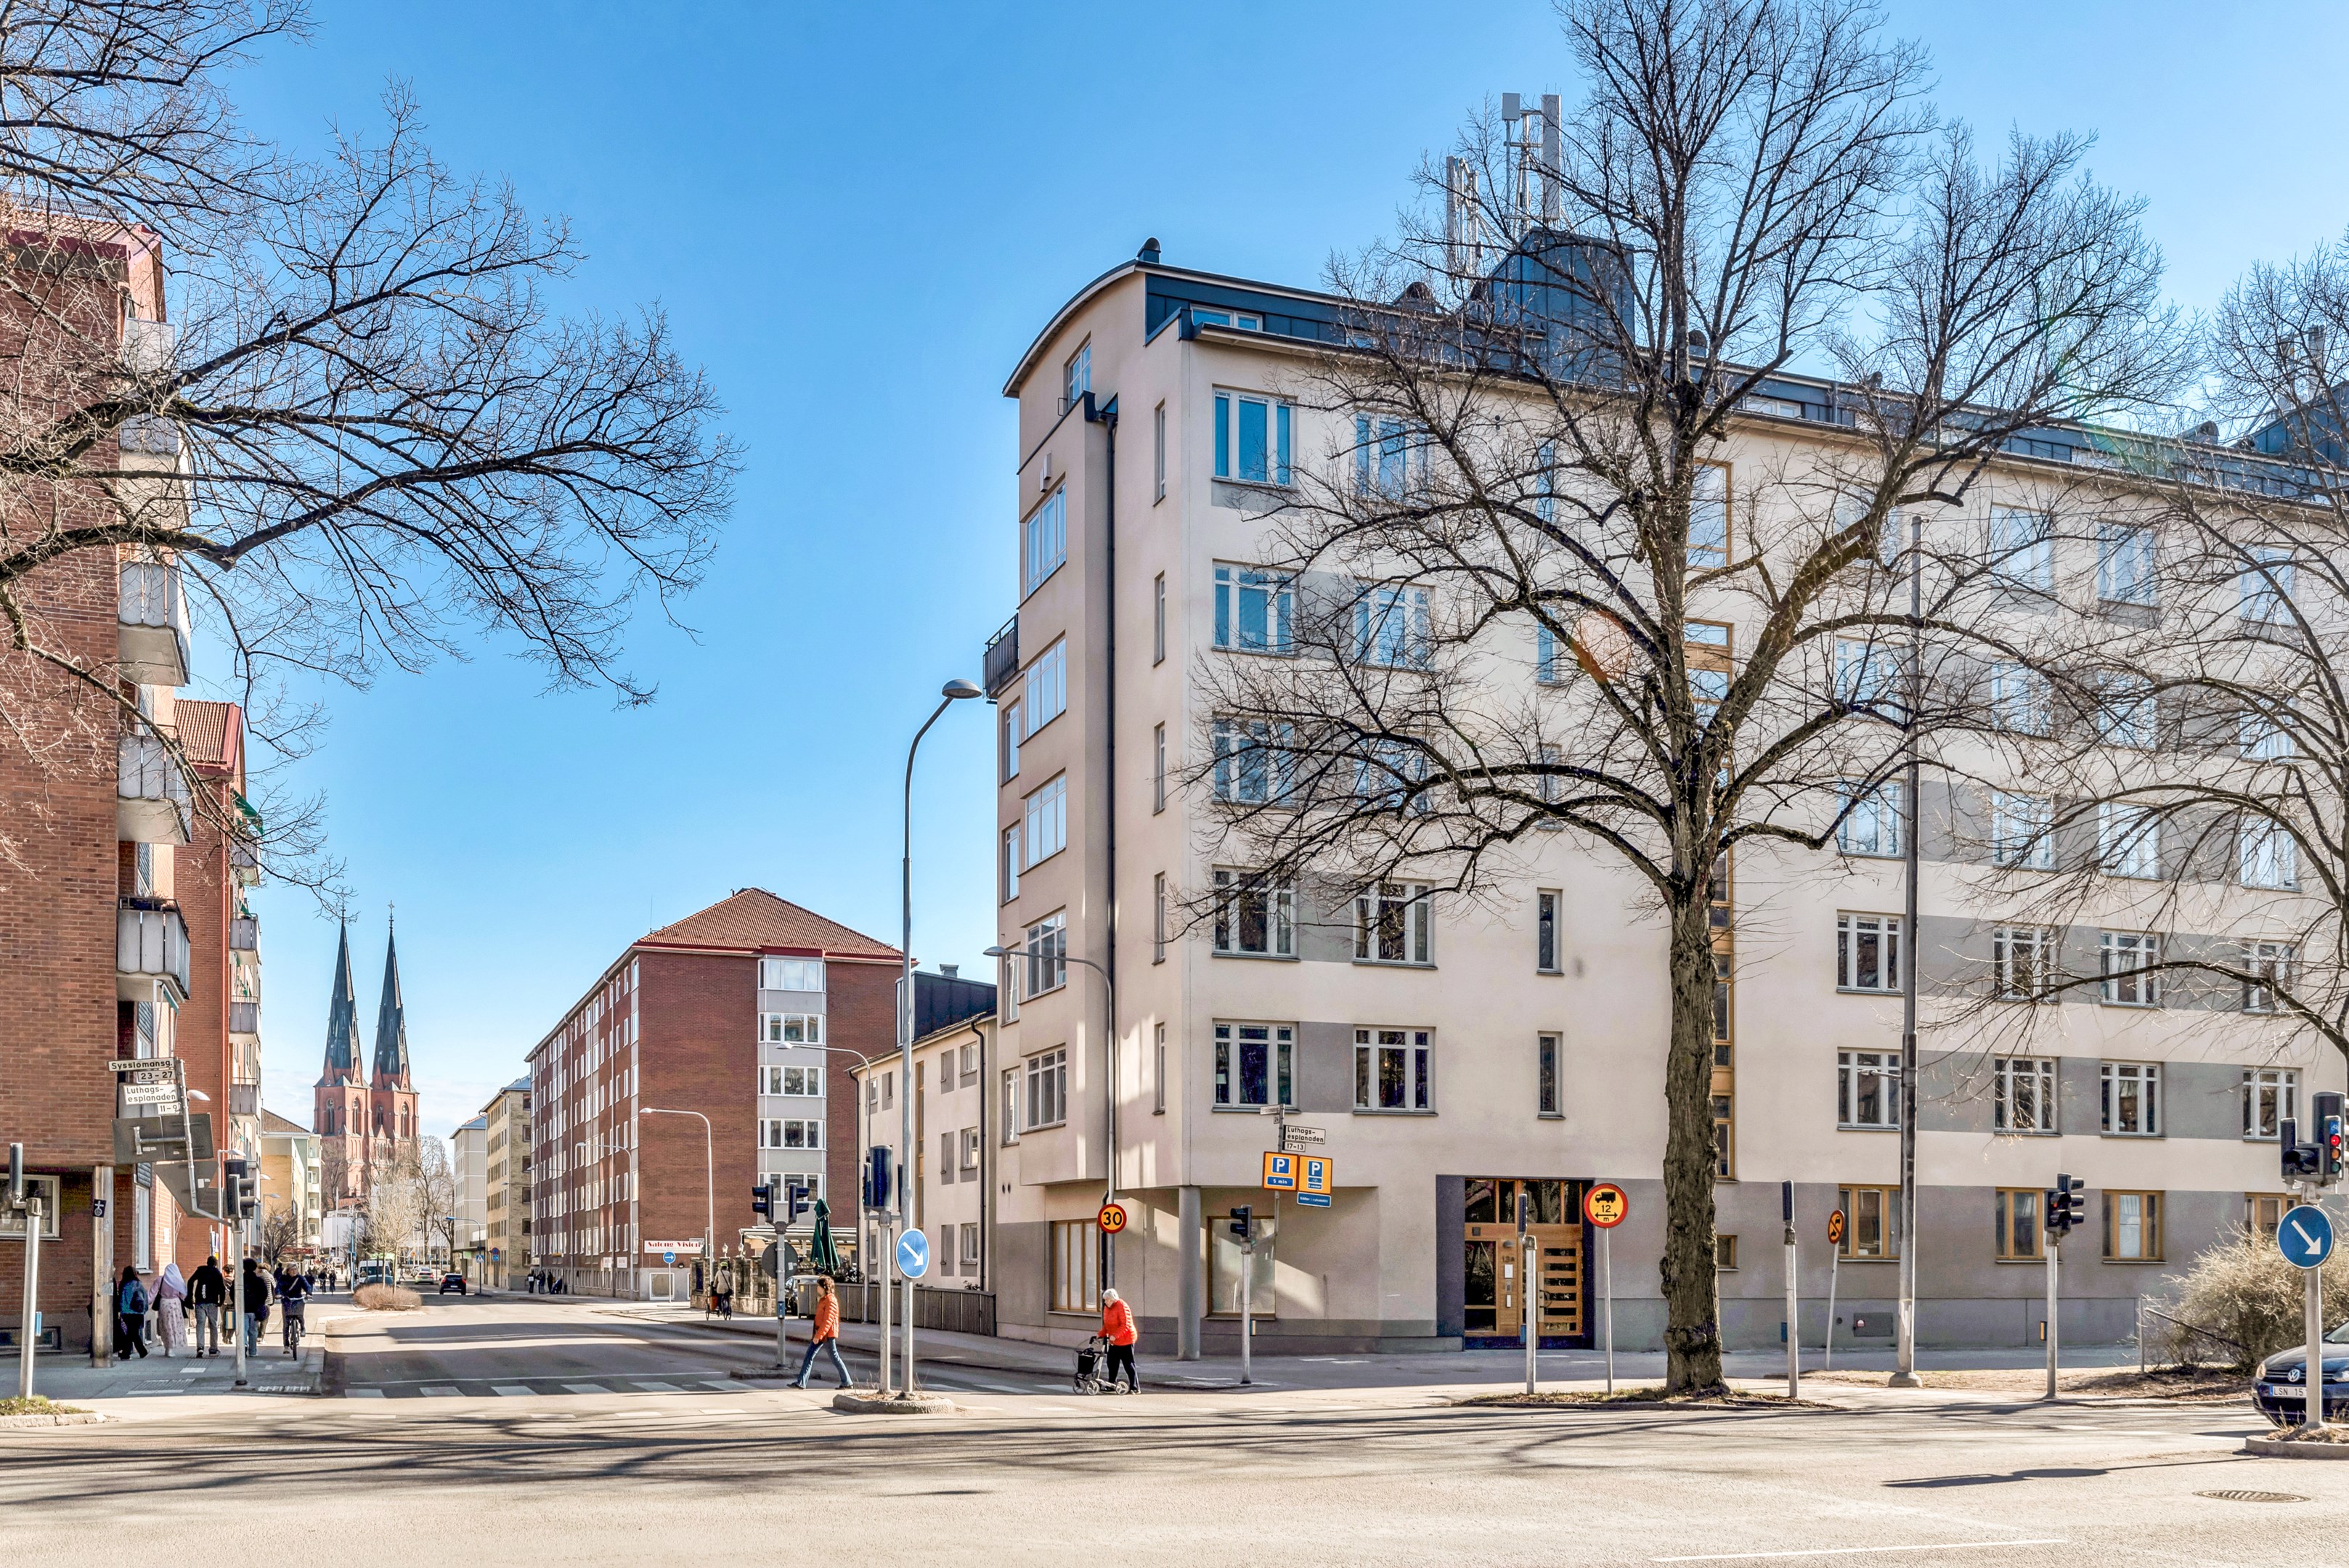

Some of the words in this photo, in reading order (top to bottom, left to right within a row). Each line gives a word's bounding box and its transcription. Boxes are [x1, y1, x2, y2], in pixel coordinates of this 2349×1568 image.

[111, 1060, 173, 1070] Sysslomansg.
[126, 1086, 164, 1095] Luthags-
[128, 1093, 176, 1103] esplanaden
[1287, 1126, 1316, 1135] Luthags-
[1287, 1134, 1324, 1143] esplanaden
[1276, 1159, 1285, 1172] P
[1311, 1162, 1321, 1175] P
[1601, 1204, 1611, 1213] 12
[1103, 1211, 1123, 1226] 30
[2273, 1387, 2288, 1396] LSN
